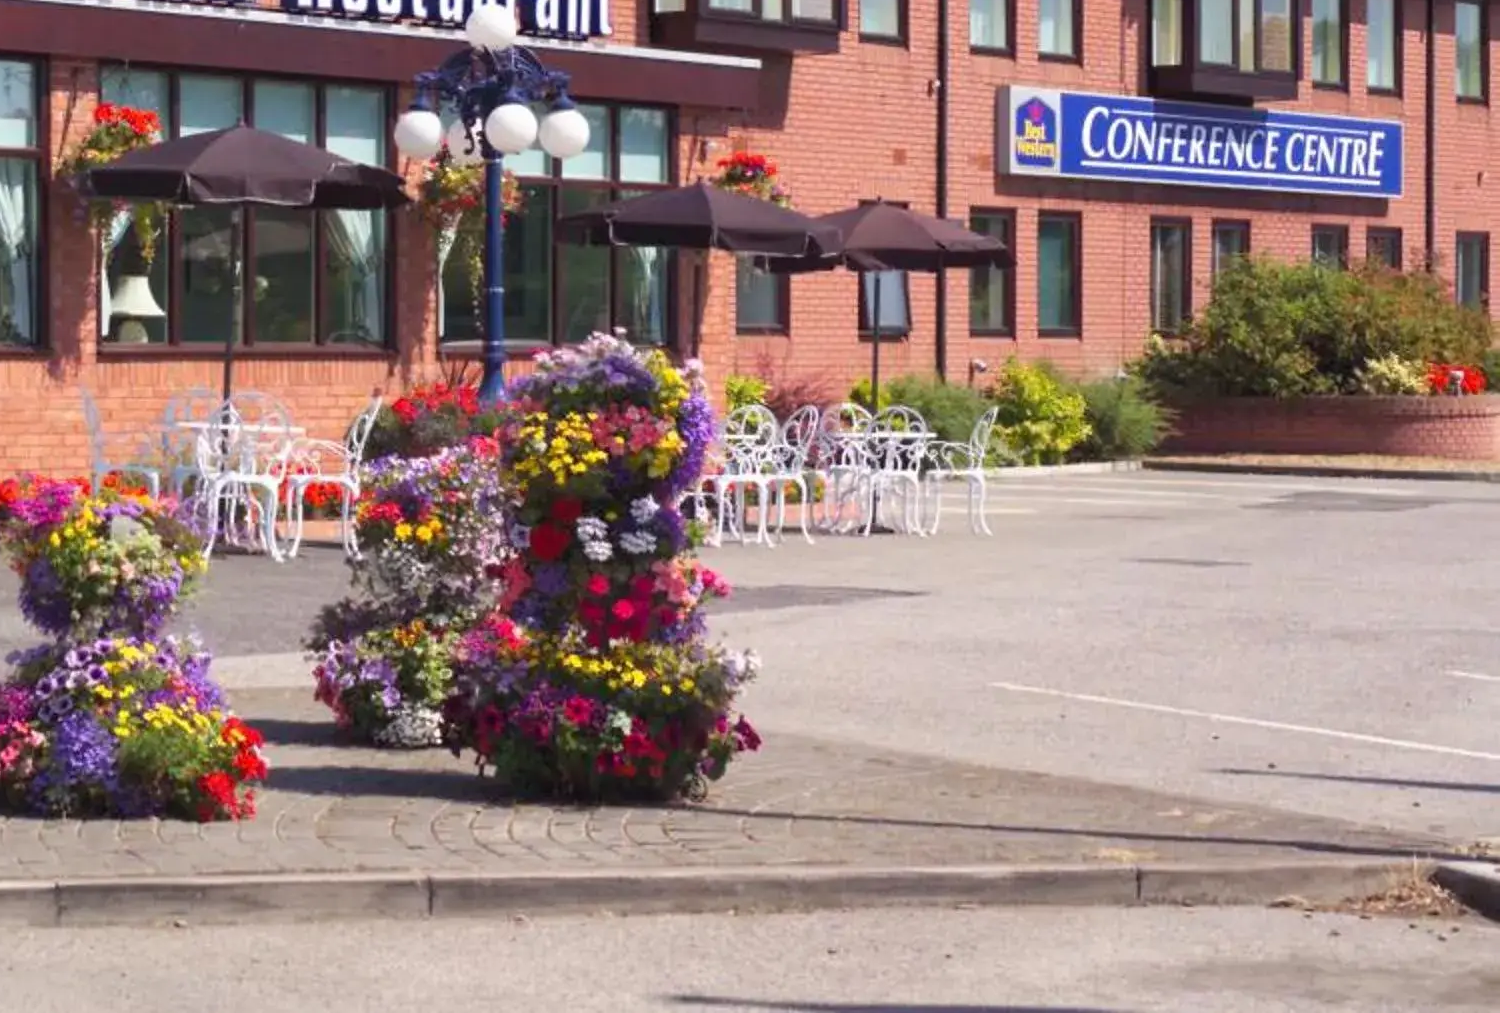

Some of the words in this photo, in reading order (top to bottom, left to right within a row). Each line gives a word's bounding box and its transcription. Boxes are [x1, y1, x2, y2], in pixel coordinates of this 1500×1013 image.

[1024, 119, 1046, 140] Best
[1016, 138, 1056, 158] Western
[1082, 106, 1280, 169] CONFERENCE
[1285, 130, 1385, 177] CENTRE
